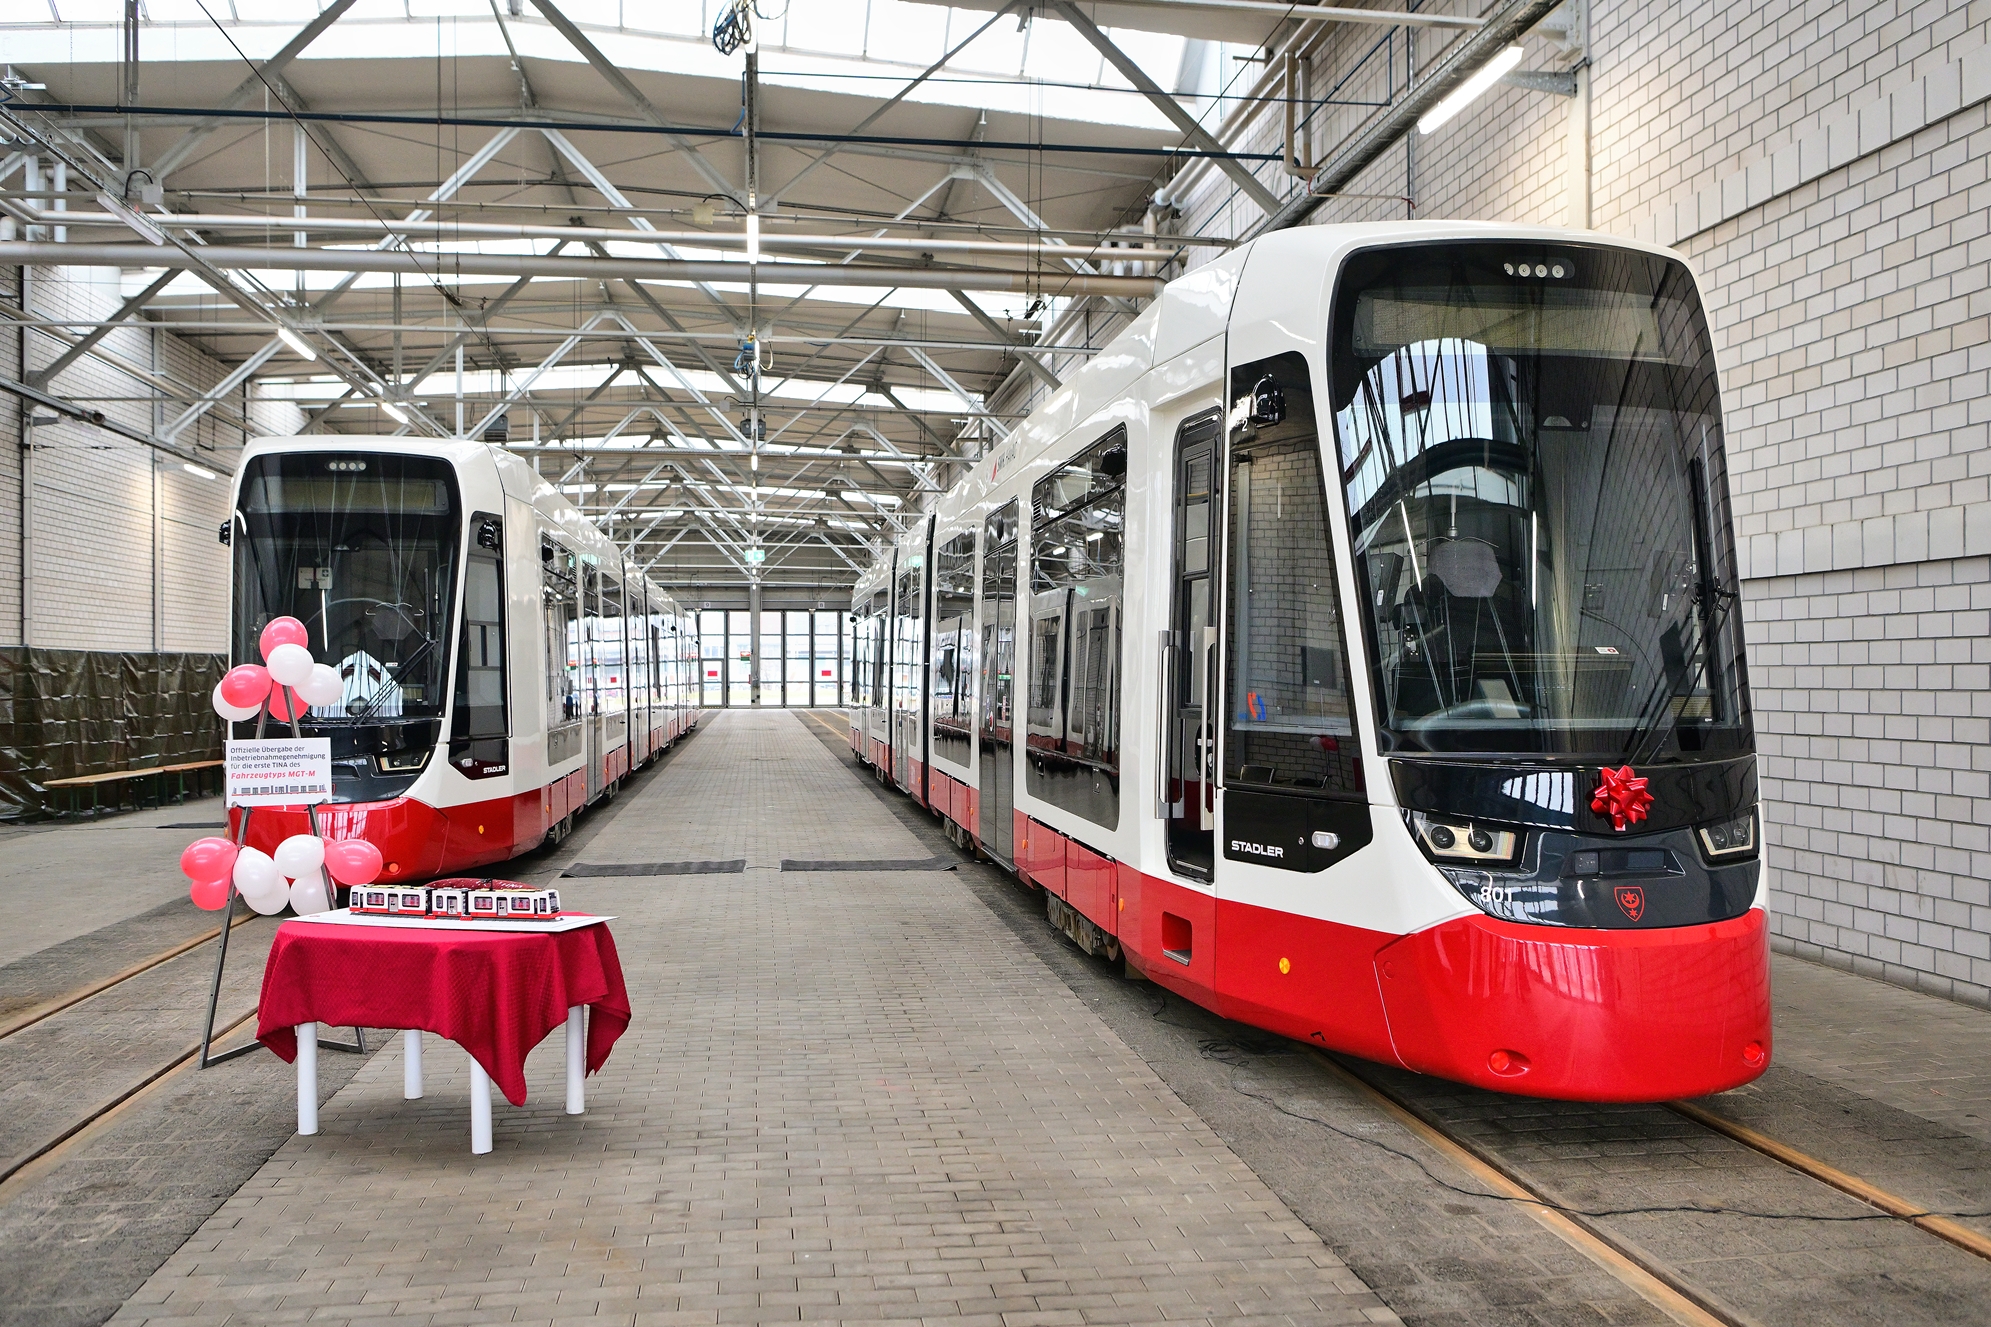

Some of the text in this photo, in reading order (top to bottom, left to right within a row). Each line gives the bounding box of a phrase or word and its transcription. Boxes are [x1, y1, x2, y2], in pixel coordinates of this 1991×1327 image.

[1242, 418, 1248, 432] 2
[261, 745, 293, 753] Übergabe
[230, 753, 326, 761] Inbetriebnahmegenehmigung
[483, 765, 506, 774] STADLER
[1231, 840, 1284, 858] STADLER
[1480, 886, 1514, 903] 801
